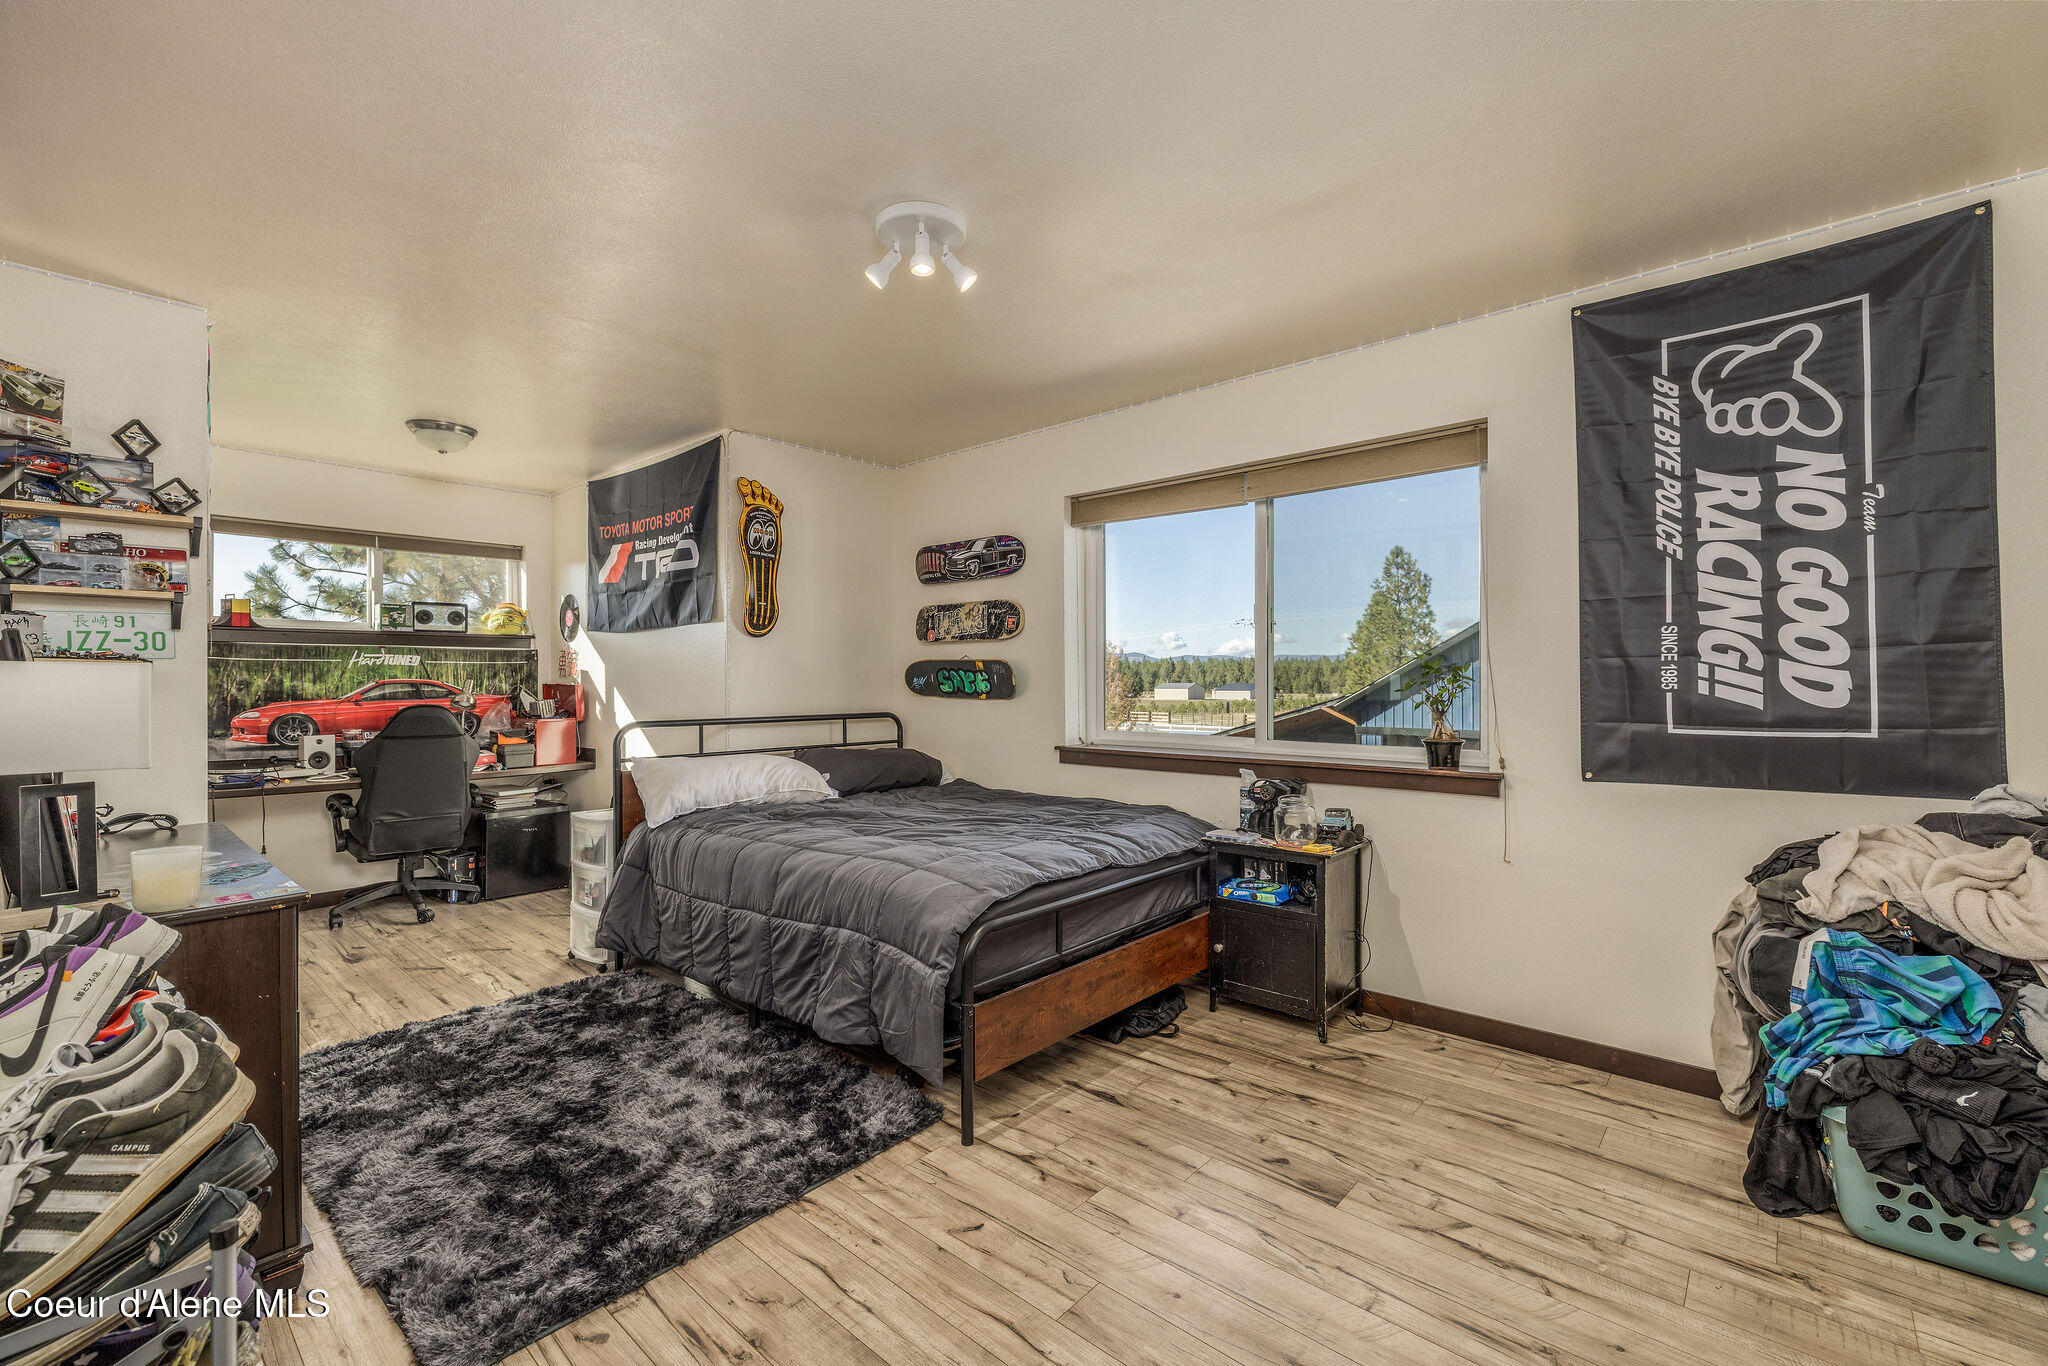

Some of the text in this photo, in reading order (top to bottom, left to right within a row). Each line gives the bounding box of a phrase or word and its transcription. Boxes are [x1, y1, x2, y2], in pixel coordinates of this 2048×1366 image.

[1652, 376, 1683, 561] BYE BYE POLICE
[600, 522, 630, 539] TOYOTA
[632, 515, 663, 534] MOTOR
[1862, 483, 1885, 532] Team
[635, 540, 657, 550] Racing
[1695, 468, 1765, 711] RACING!!
[1775, 445, 1852, 709] NO GOOD
[57, 630, 166, 651] JZZ-30
[74, 614, 136, 628] 長崎 91
[1660, 625, 1678, 689] SINCE 1985
